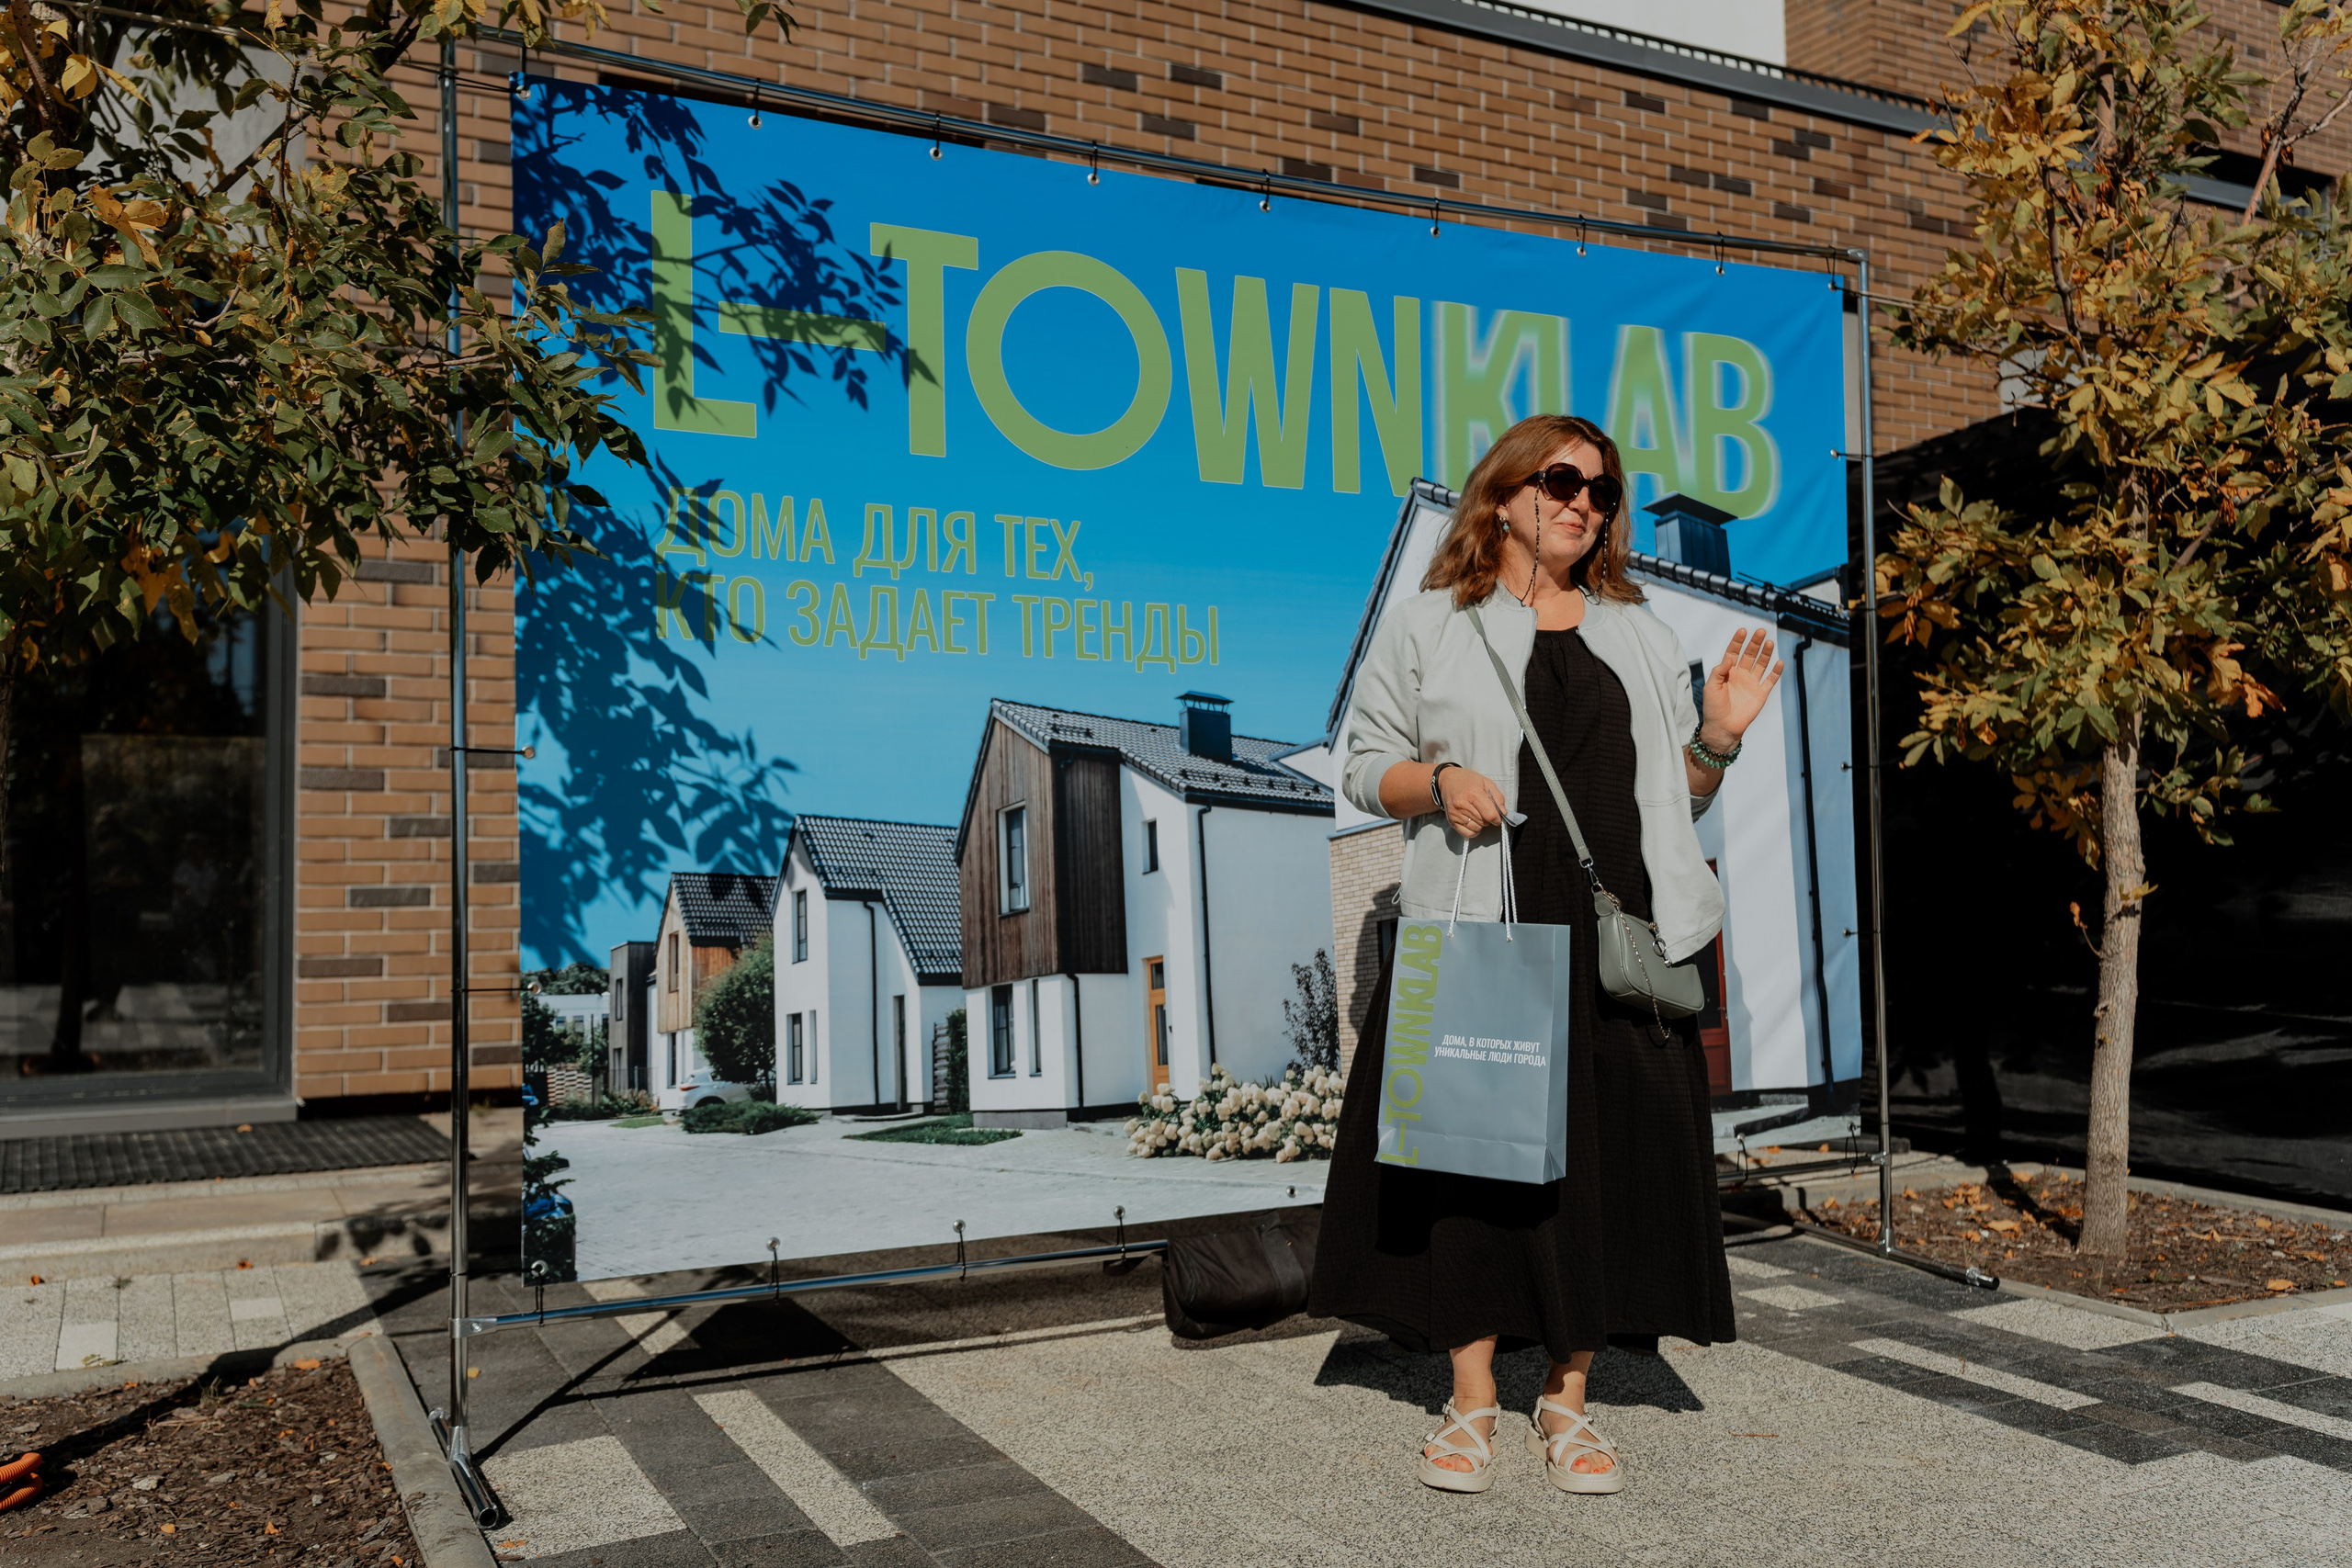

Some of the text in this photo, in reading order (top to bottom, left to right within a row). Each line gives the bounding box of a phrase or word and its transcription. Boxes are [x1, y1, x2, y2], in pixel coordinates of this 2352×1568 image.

[655, 486, 1094, 592] ДОМА ДЛЯ ТЕХ,
[655, 571, 1220, 674] КТО ЗАДАЕТ ТРЕНДЫ
[1434, 1046, 1546, 1066] УНИКАЛЬНЫЕ ЛЮДИ ГОРОДА
[1442, 1034, 1541, 1053] ДОМА, В КОТОРЫХ ЖИВУТ
